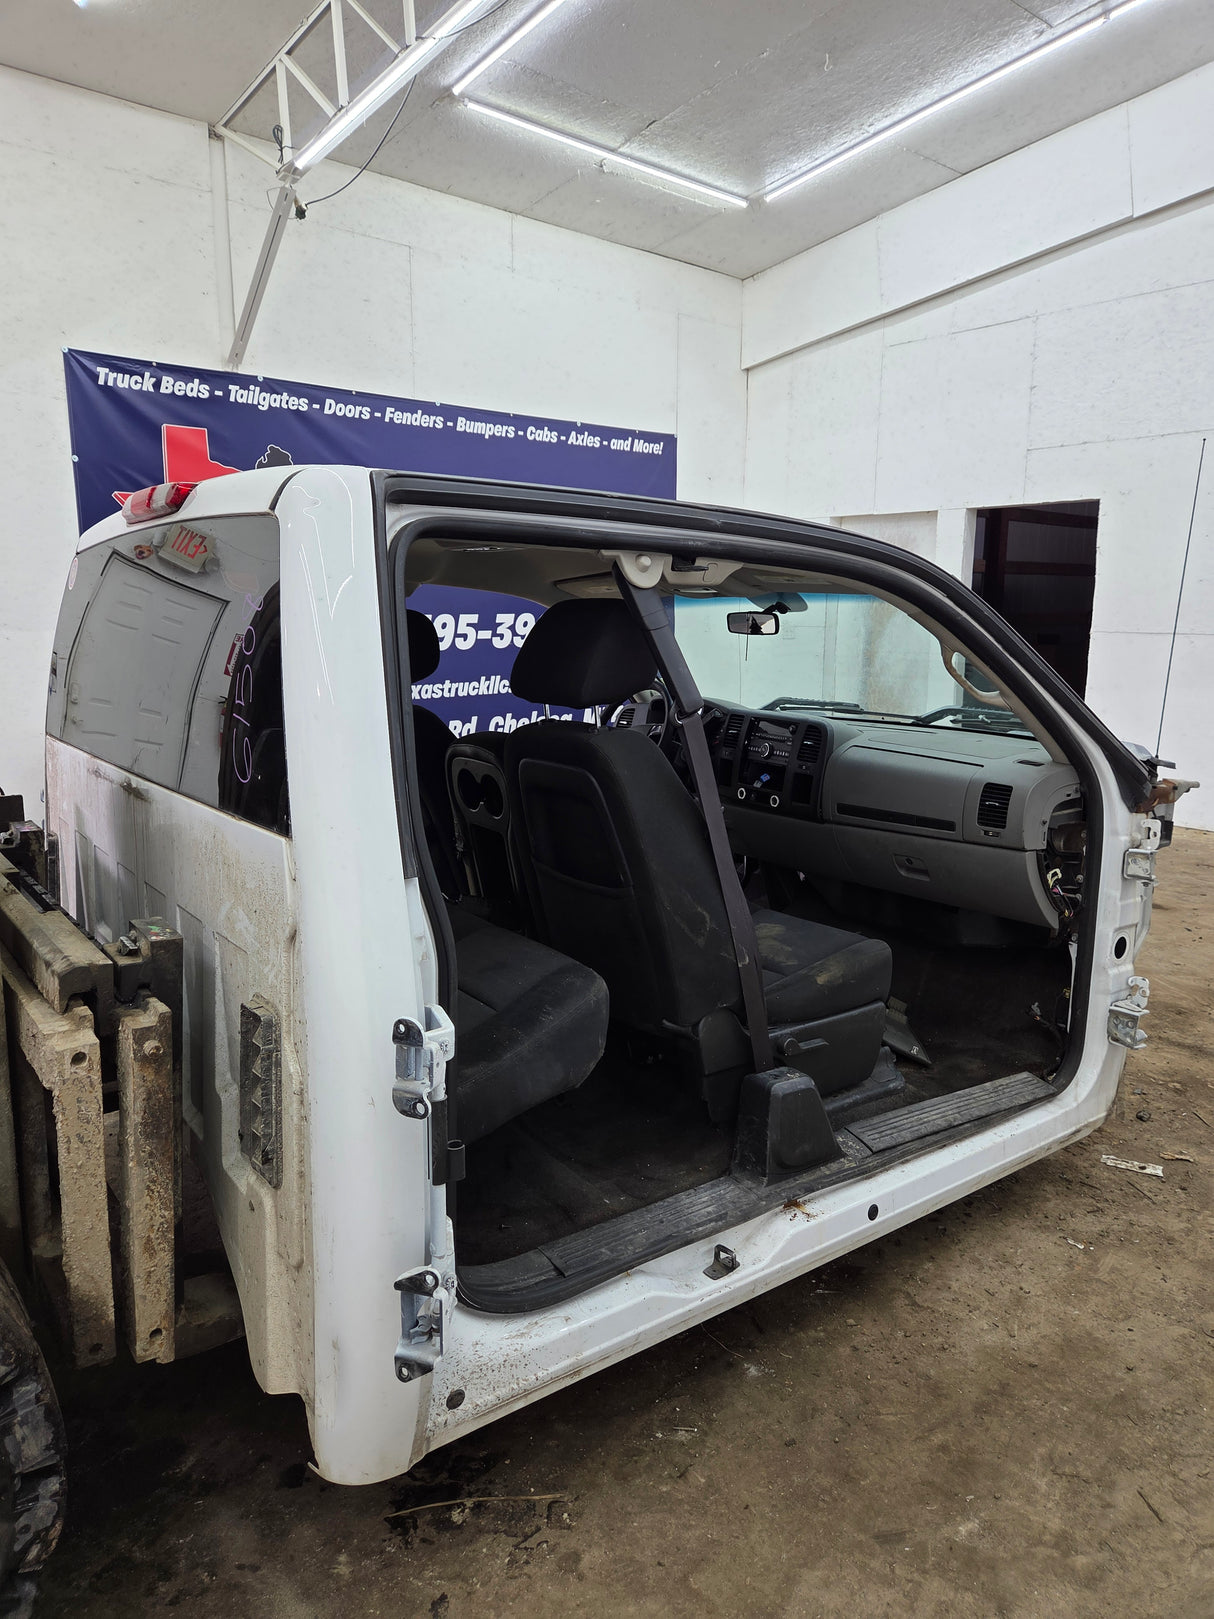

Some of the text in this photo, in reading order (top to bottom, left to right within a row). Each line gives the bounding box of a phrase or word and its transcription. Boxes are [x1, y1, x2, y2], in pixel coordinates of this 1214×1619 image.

[96, 366, 157, 392] Truck
[160, 376, 210, 399] Beds
[229, 385, 309, 411] Tailgates
[324, 398, 371, 420] Doors
[385, 406, 444, 429] Fenders
[456, 417, 515, 439] Bumpers
[526, 425, 558, 443] Cabs
[568, 431, 600, 448] Axles
[610, 437, 632, 452] and
[633, 438, 664, 455] More!
[424, 612, 536, 651] 95-39
